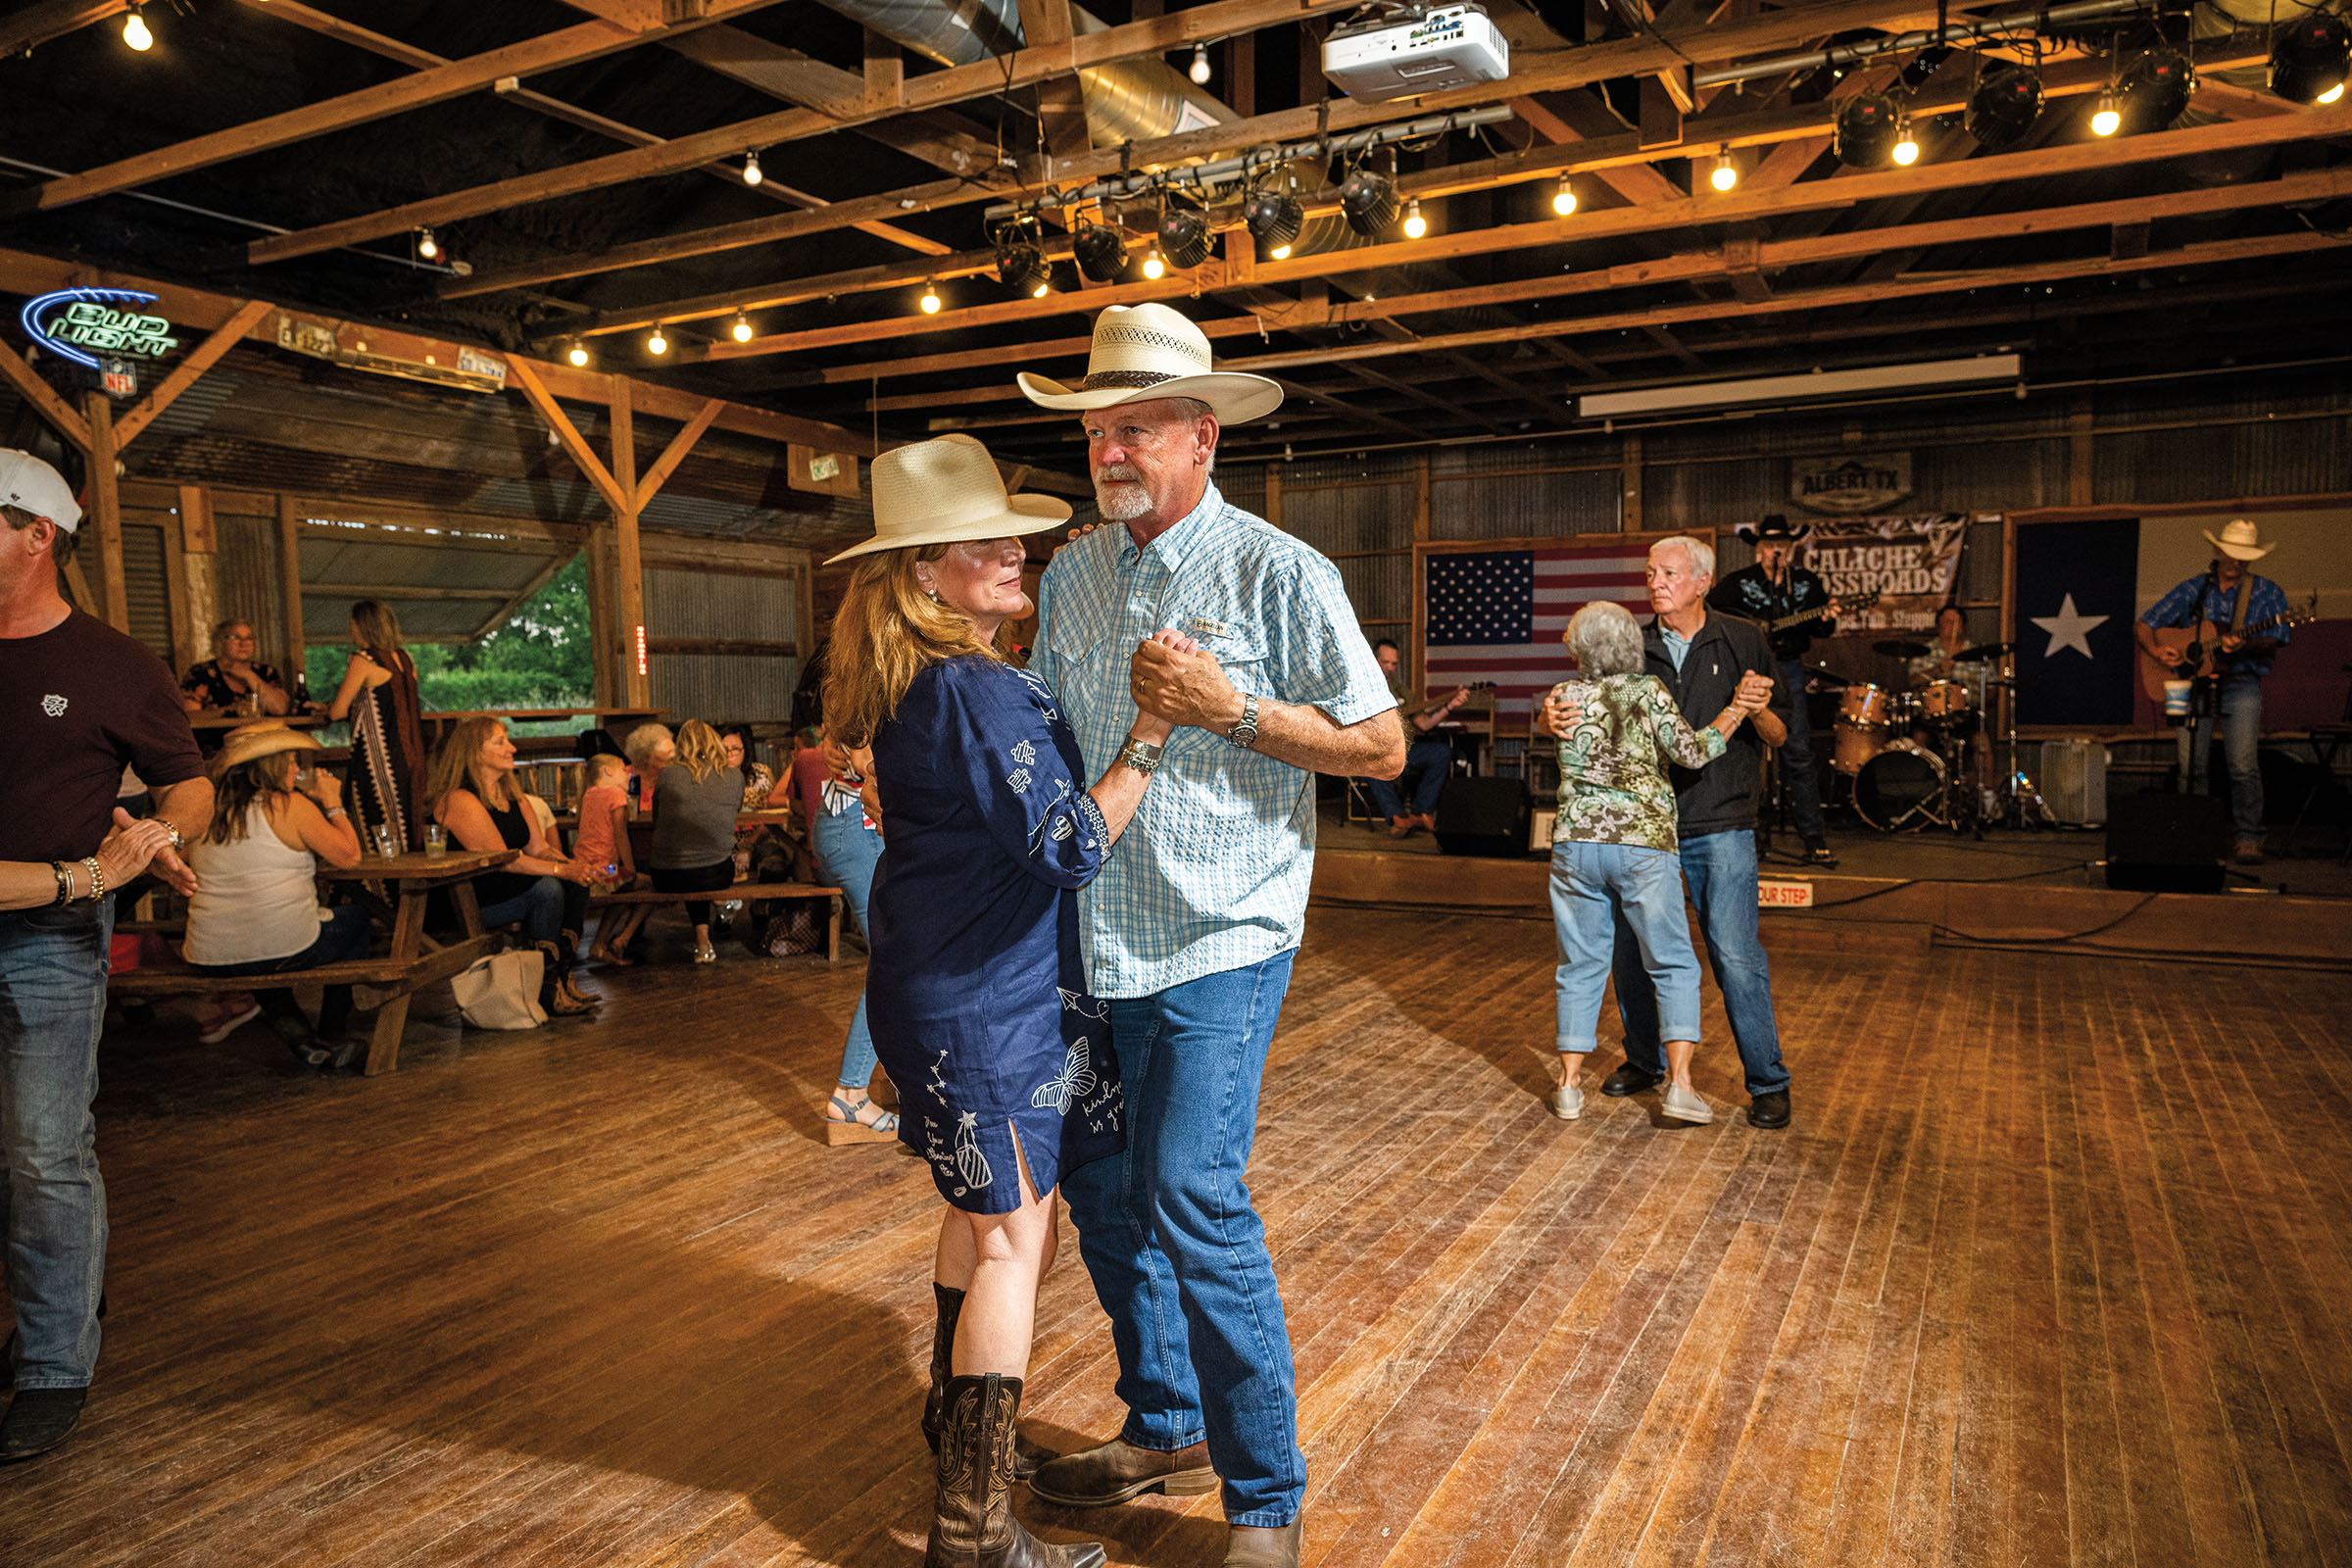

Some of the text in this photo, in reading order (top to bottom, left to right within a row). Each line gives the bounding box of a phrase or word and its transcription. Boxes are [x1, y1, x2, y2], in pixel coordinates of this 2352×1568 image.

[67, 303, 169, 336] BUD
[47, 318, 177, 355] LIGHT
[105, 372, 133, 393] NFL
[1804, 472, 1869, 495] ALBERT
[1803, 545, 1923, 573] CALICHE
[1817, 567, 1945, 597] OSSROADS
[1758, 886, 1807, 905] OUR STEP
[1082, 1081, 1122, 1117] kindn
